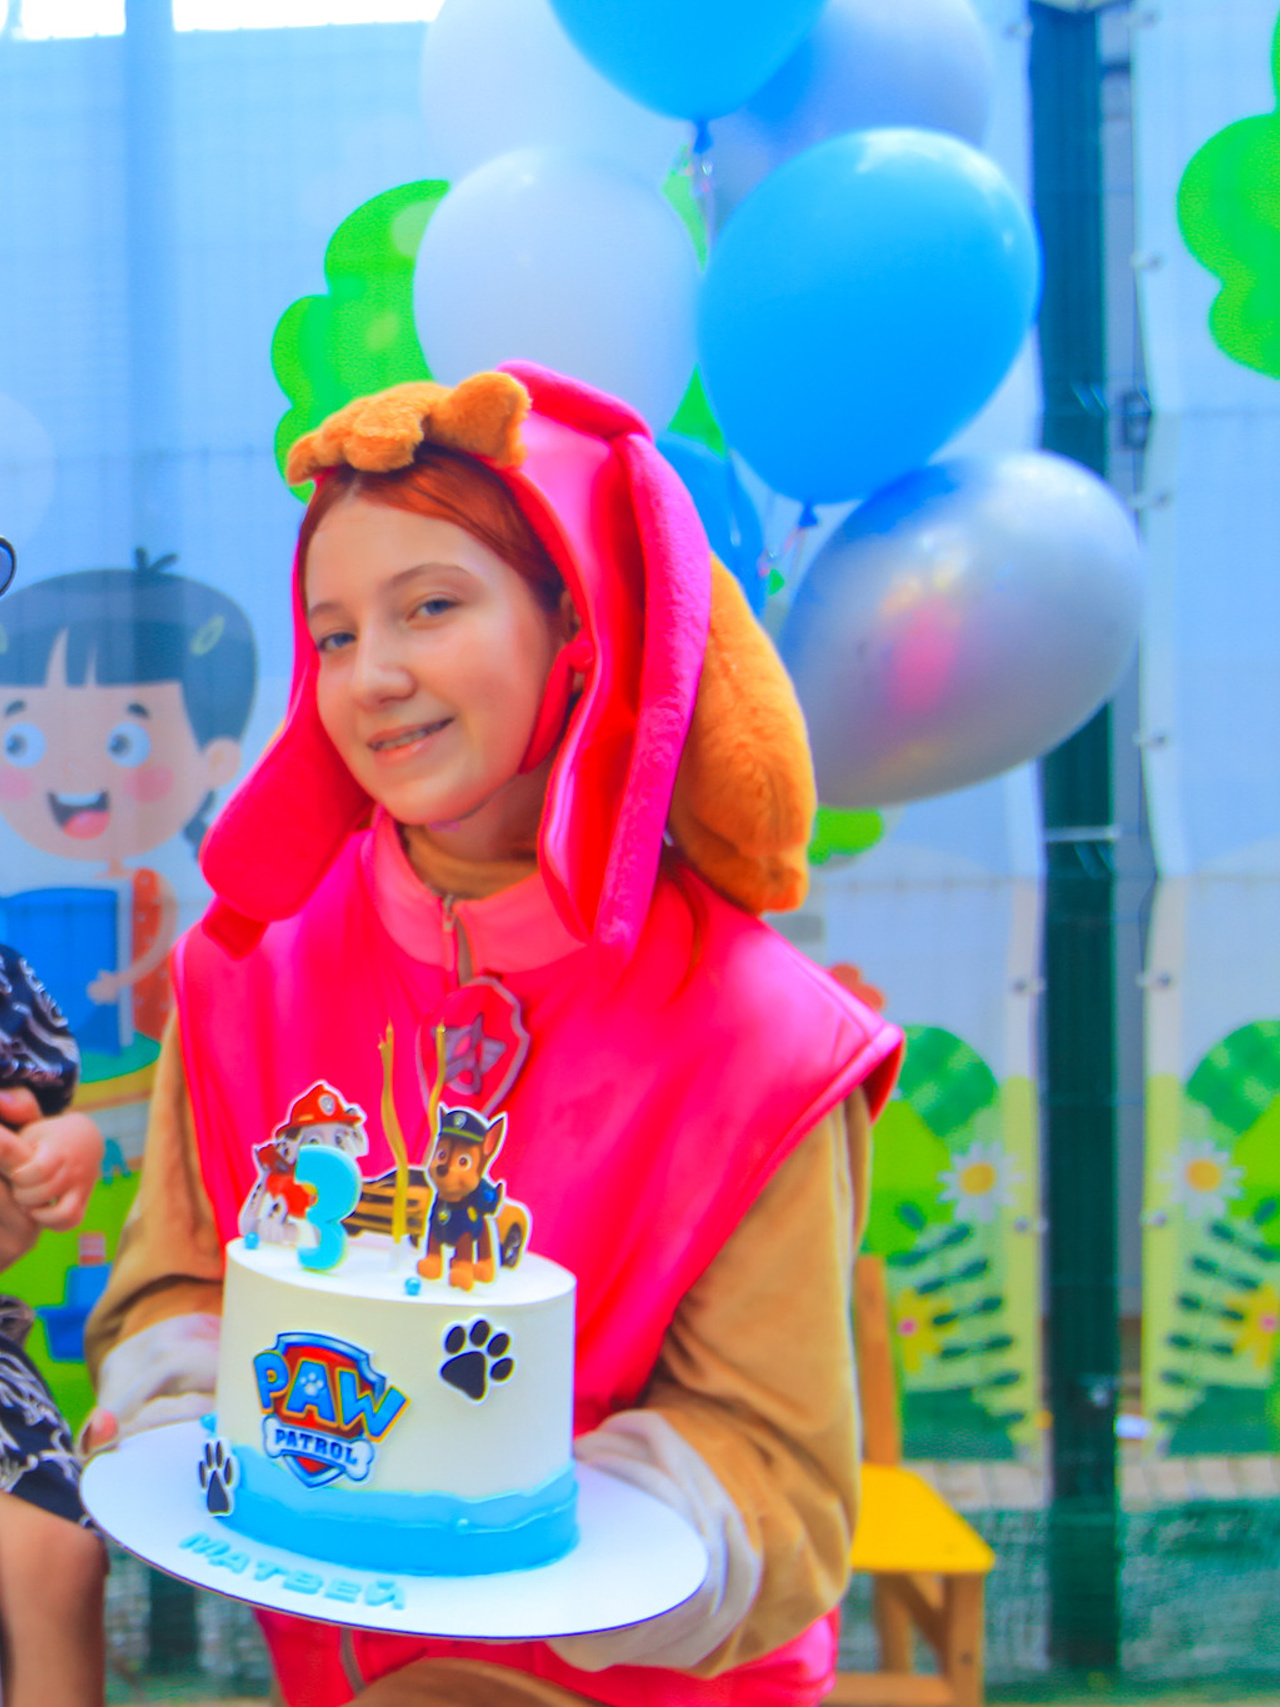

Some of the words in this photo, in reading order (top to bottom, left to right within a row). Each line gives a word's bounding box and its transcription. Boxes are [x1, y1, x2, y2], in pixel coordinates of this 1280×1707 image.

[294, 1144, 361, 1272] 3
[252, 1350, 410, 1443] PAW
[275, 1428, 358, 1466] PATROL
[178, 1532, 406, 1611] МАТВЕЙ
